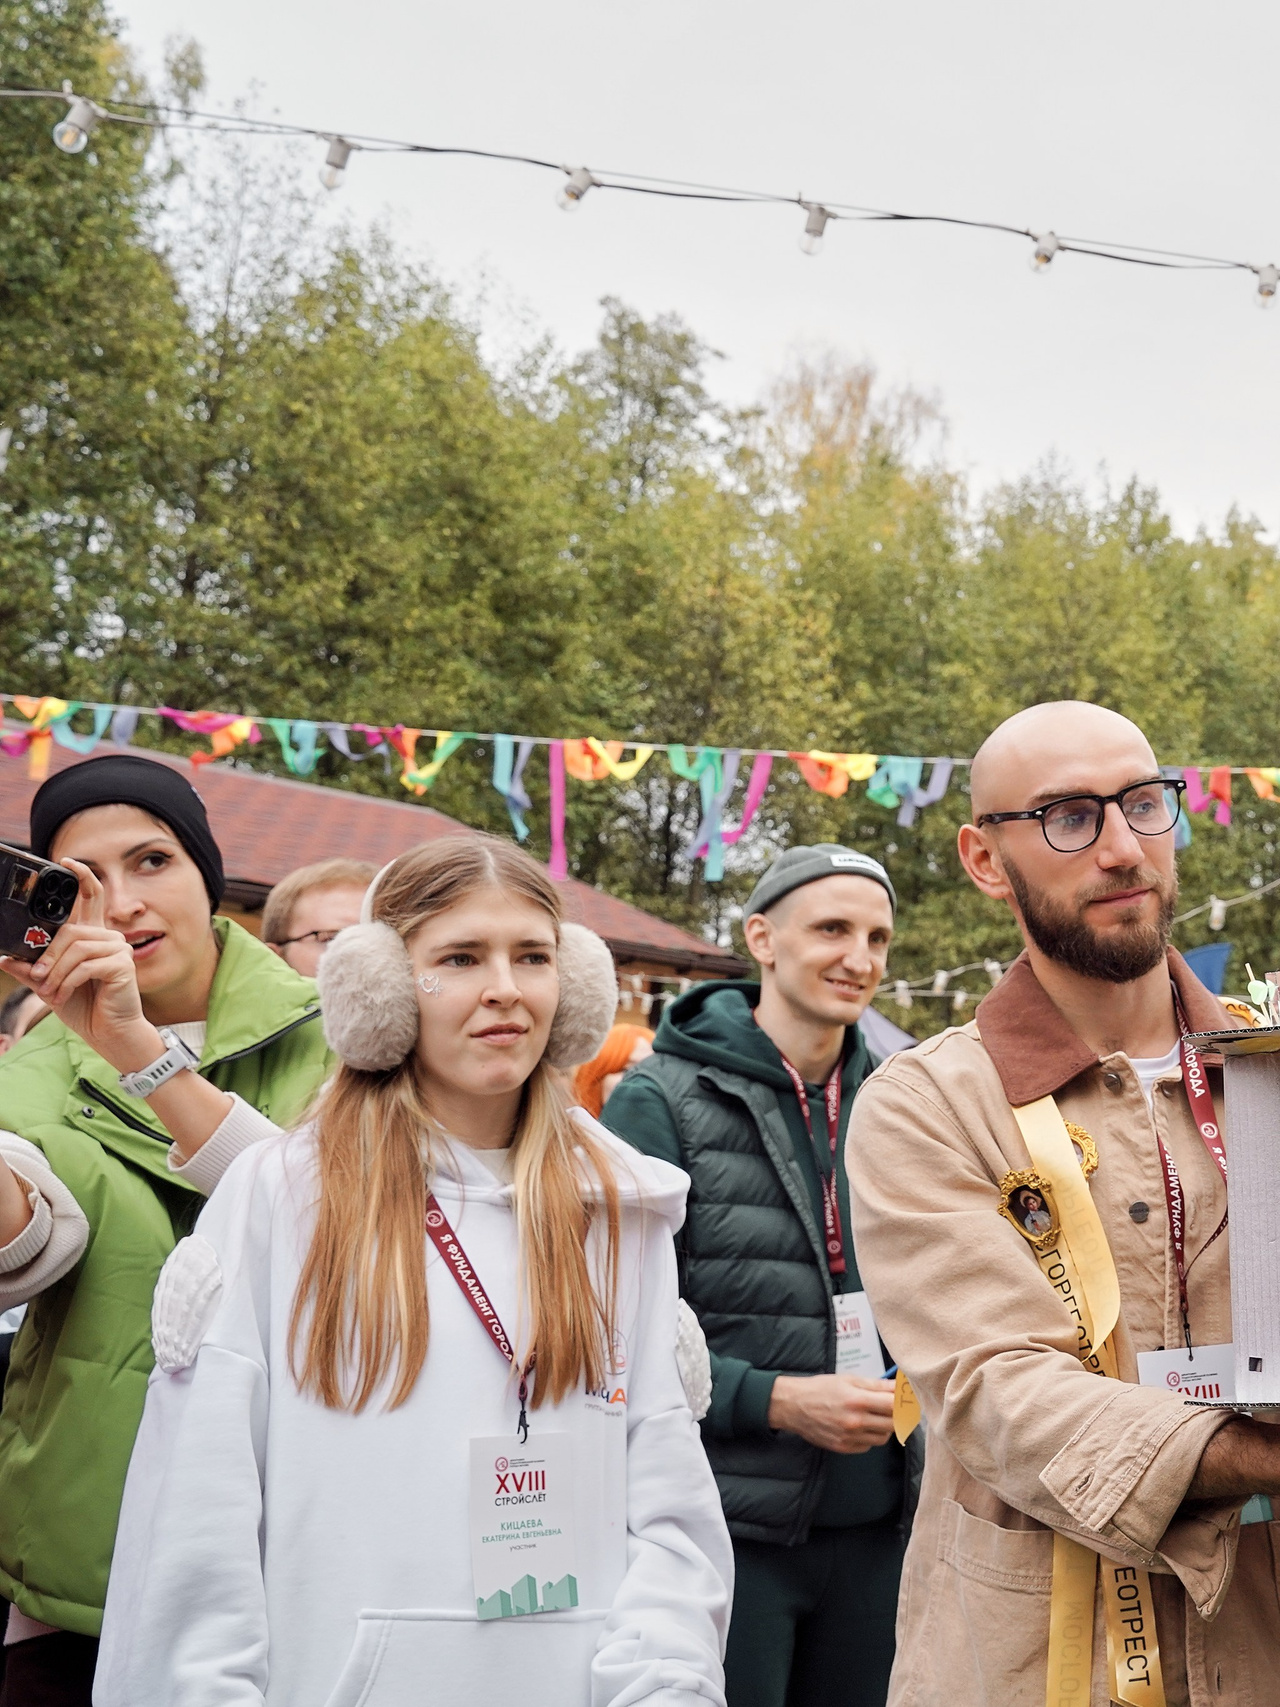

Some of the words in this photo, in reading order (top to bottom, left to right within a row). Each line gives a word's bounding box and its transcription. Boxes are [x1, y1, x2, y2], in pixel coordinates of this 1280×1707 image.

[1175, 1242, 1182, 1250] Я
[440, 1233, 453, 1244] Я
[447, 1243, 495, 1317] ФУНДАМЕНТ
[496, 1470, 545, 1494] XVIII
[495, 1493, 546, 1506] СТРОЙСЛЁТ
[500, 1519, 543, 1531] КИЦАЕВА
[482, 1532, 521, 1543] ЕКАТЕРИНА
[522, 1528, 562, 1539] ЕВГЕНЬЕВНА
[1114, 1566, 1151, 1687] ЕОТРЕСТ
